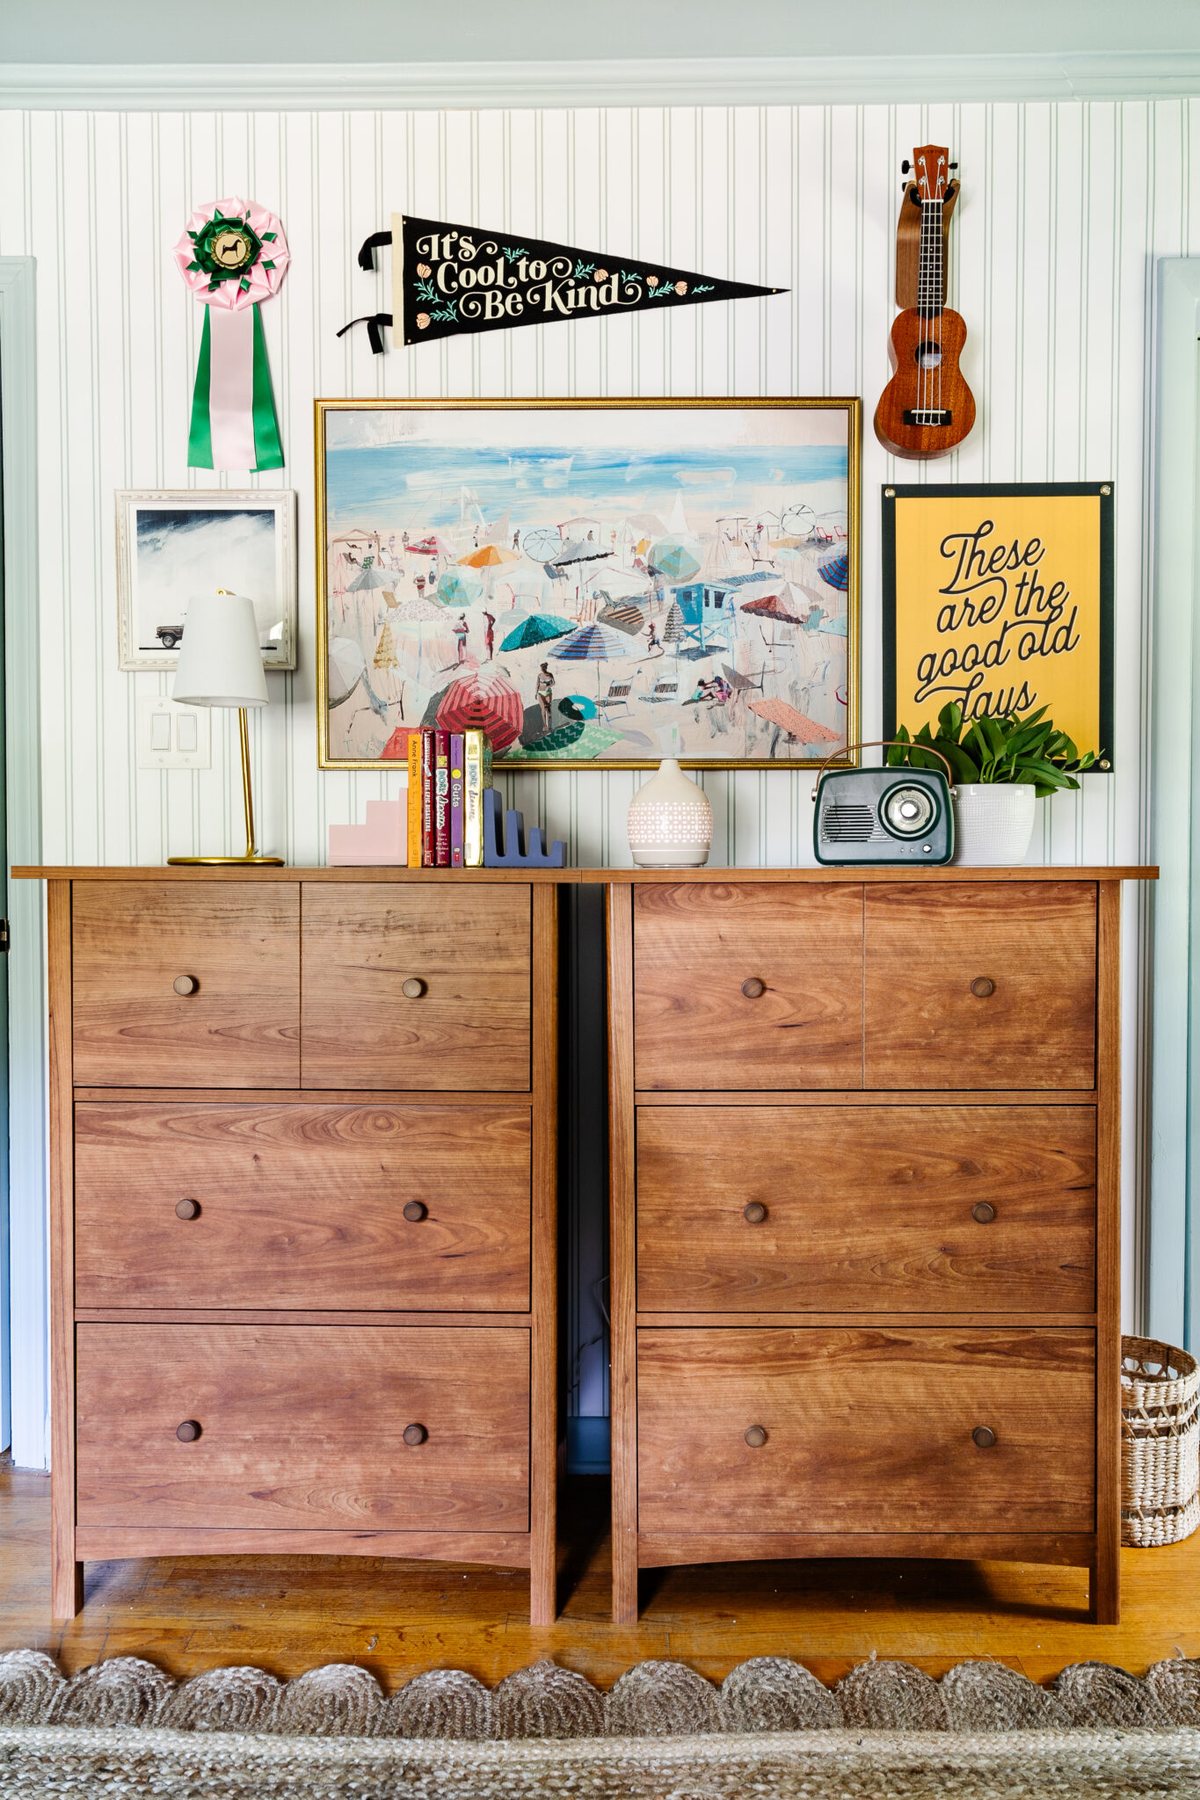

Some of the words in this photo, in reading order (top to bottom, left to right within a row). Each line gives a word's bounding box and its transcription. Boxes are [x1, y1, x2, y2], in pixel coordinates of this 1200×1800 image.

[416, 231, 498, 262] It's
[437, 256, 518, 294] Cool
[516, 256, 573, 282] to
[459, 290, 524, 320] Be
[526, 271, 642, 316] Kind
[939, 520, 1045, 592] These
[937, 588, 1007, 633] are
[1014, 569, 1070, 617] the
[915, 620, 1010, 690] good
[1018, 605, 1080, 661] old
[946, 672, 1037, 723] days
[452, 783, 461, 808] Guts
